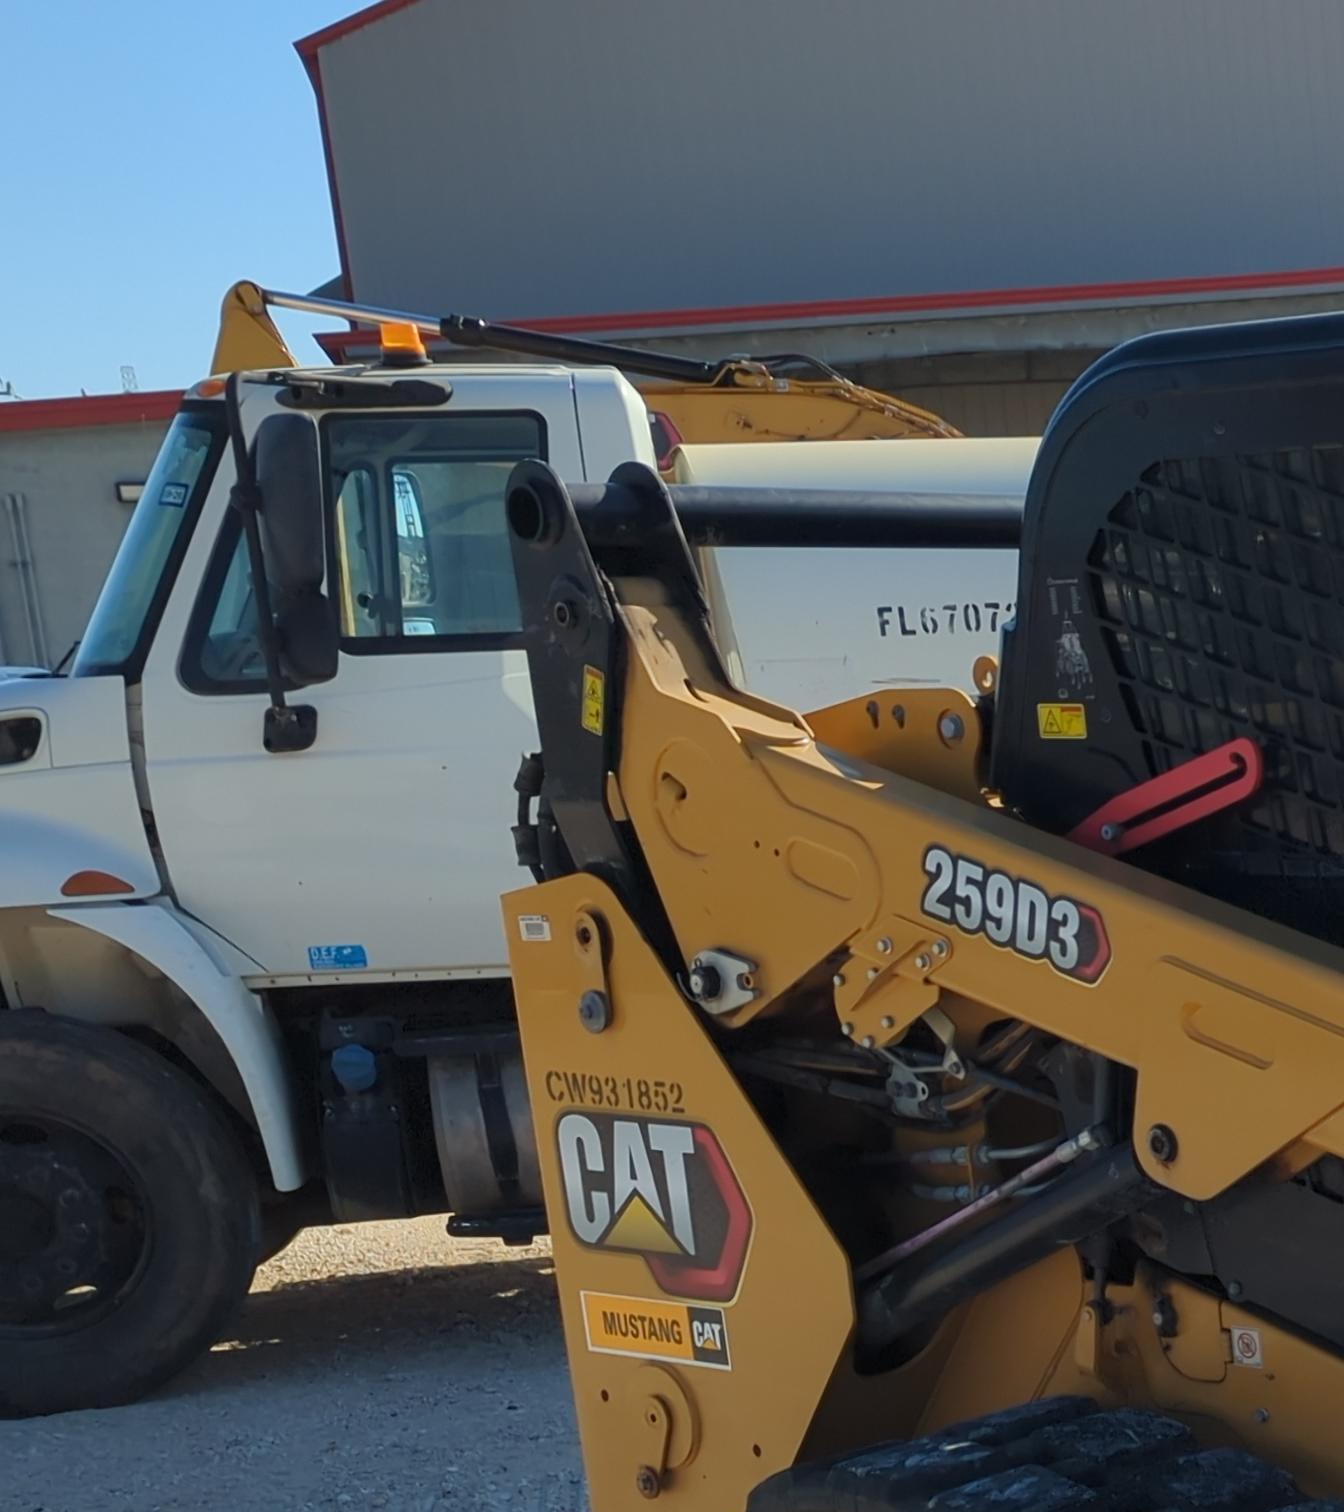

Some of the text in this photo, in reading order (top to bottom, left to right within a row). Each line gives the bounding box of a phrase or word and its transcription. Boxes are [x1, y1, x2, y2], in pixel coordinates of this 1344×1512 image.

[923, 847, 1081, 970] 259D3
[545, 1070, 686, 1113] CW931852
[557, 1113, 697, 1256] CAT
[602, 1310, 722, 1351] MUSTANG CAT
